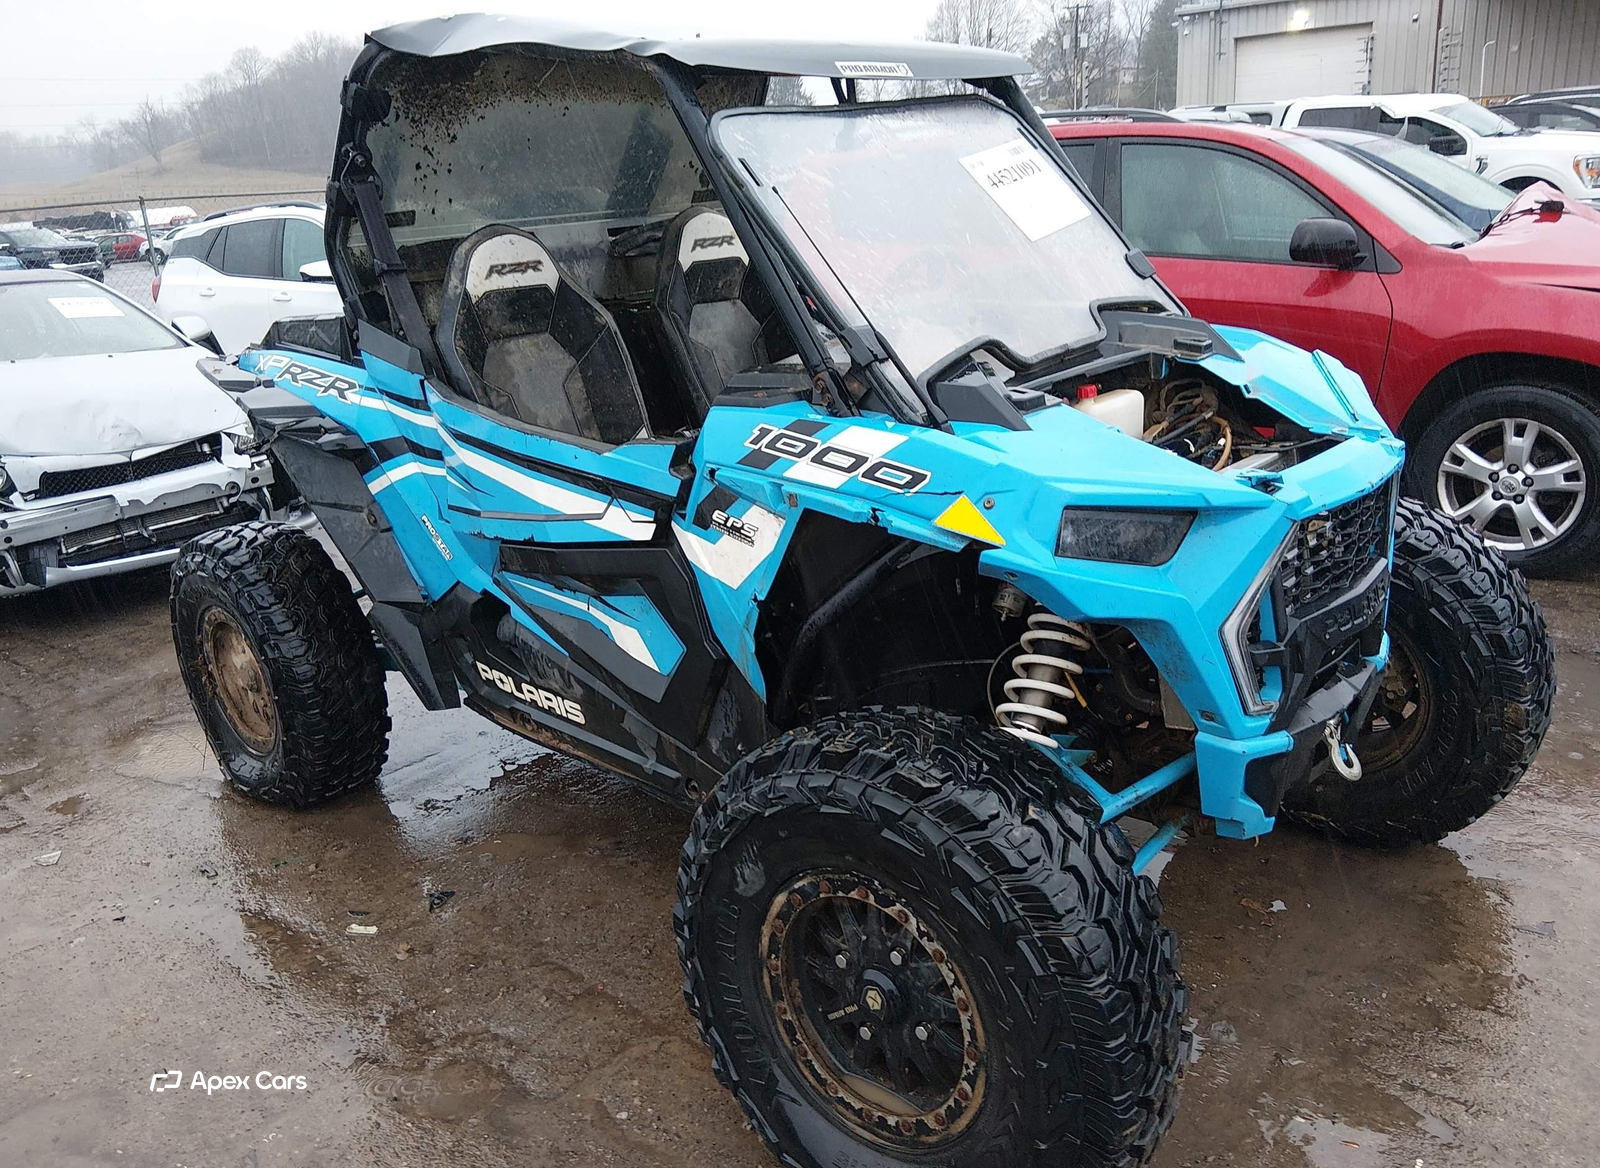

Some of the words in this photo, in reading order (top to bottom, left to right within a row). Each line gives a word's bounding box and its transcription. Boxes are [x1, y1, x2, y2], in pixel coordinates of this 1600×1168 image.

[840, 64, 863, 73] PRO
[986, 158, 1042, 188] 44521091
[690, 234, 736, 253] RZR
[484, 259, 545, 281] RZR
[254, 354, 291, 374] XP
[274, 360, 360, 405] RZR
[743, 423, 932, 497] 1000
[421, 514, 453, 561] PROSTAR
[711, 508, 760, 538] EPS
[475, 660, 586, 725] POLARIS
